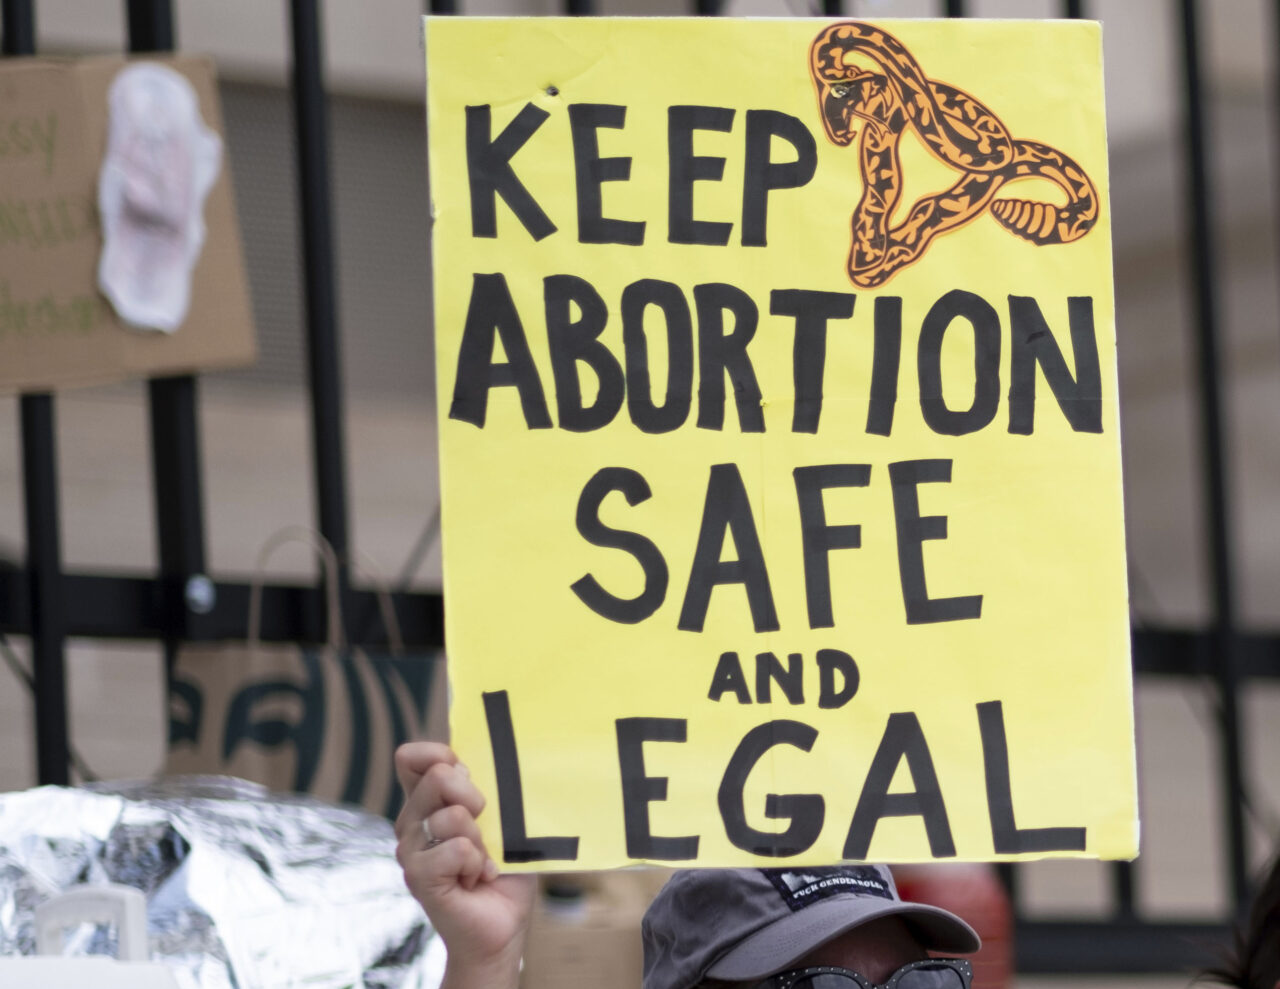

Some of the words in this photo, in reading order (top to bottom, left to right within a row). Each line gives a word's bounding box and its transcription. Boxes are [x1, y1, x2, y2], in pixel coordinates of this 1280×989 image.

[464, 101, 819, 248] KEEP
[448, 272, 1104, 437] ABORTION
[569, 457, 984, 635] SAFE
[706, 647, 860, 710] AND
[481, 689, 1087, 863] LEGAL
